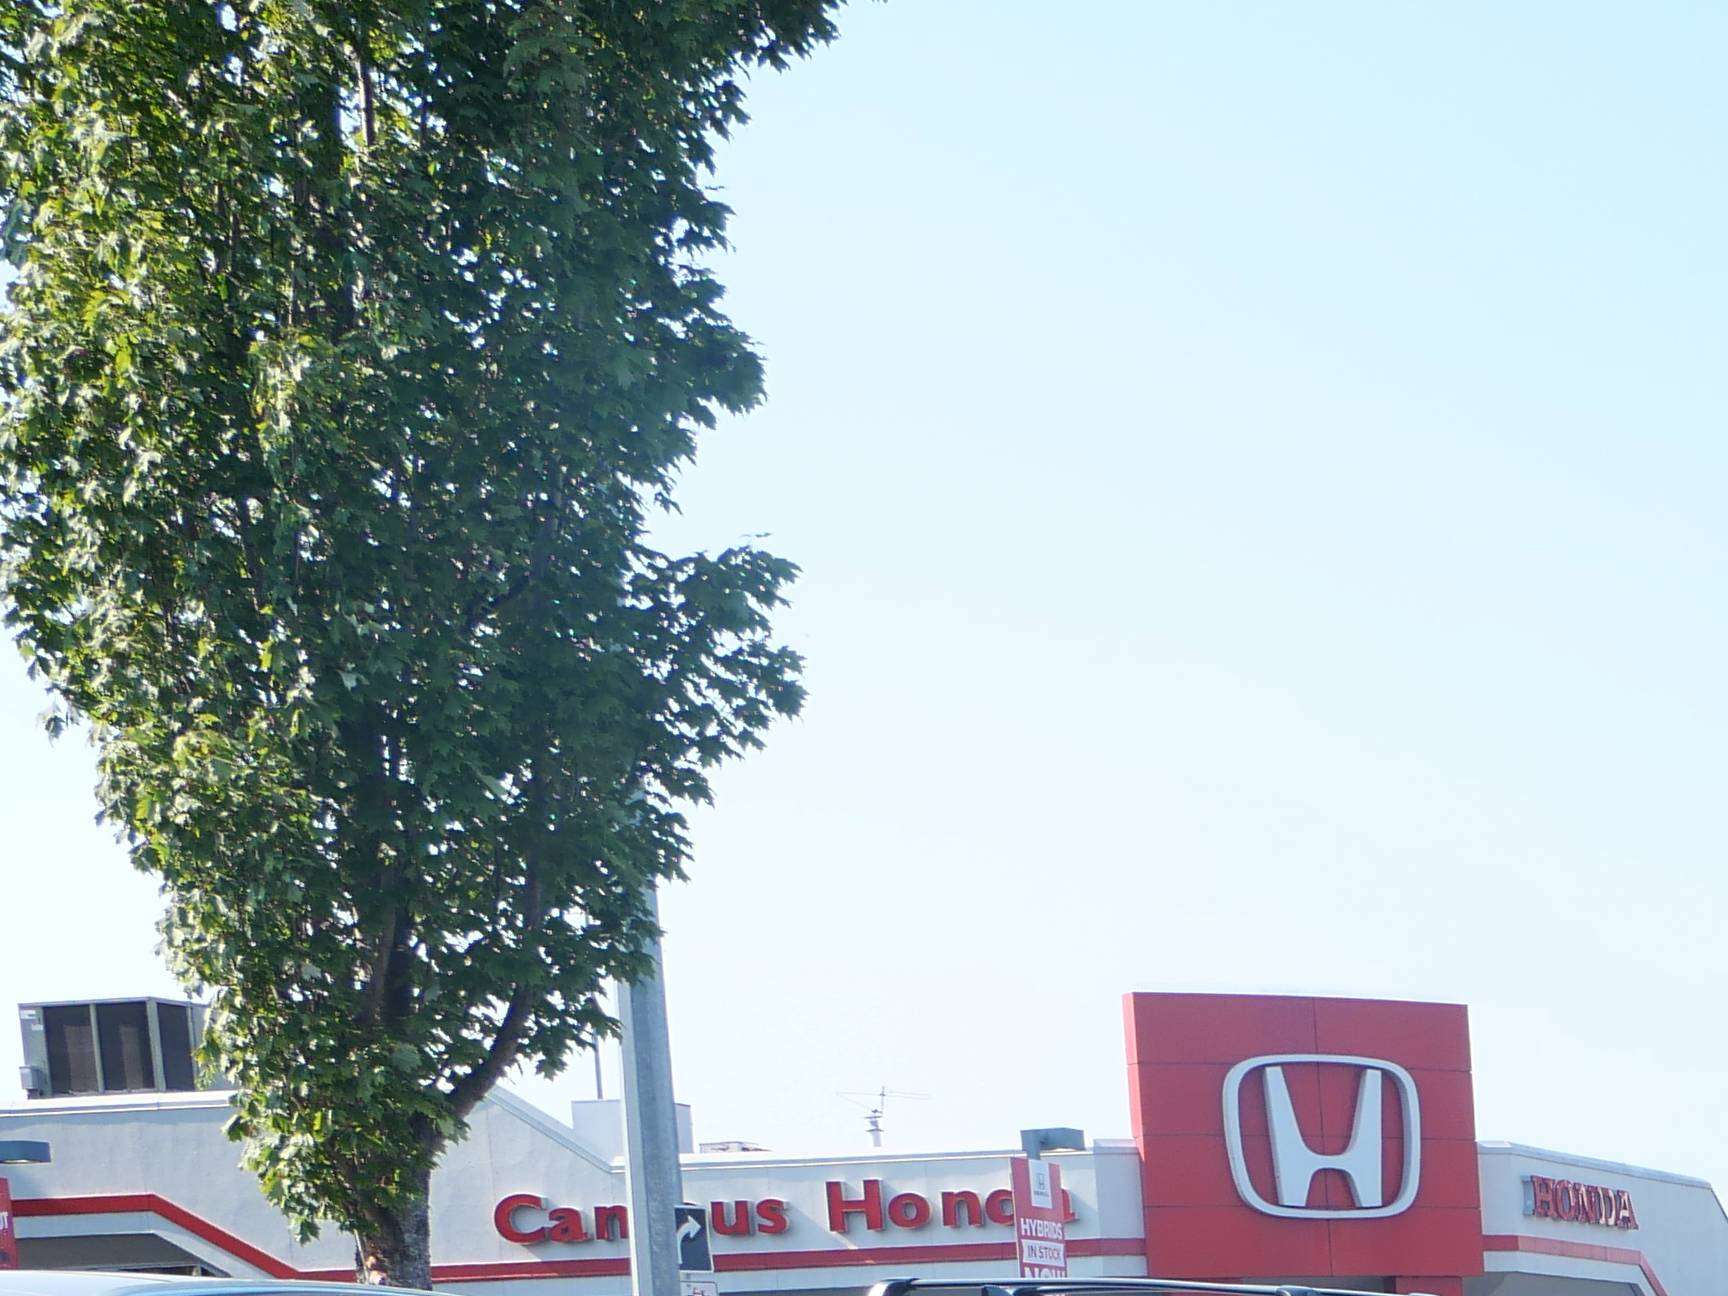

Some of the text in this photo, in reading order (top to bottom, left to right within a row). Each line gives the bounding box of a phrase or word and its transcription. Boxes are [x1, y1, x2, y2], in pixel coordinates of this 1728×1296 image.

[1522, 1174, 1639, 1231] HONDA
[1020, 1217, 1063, 1240] HYBRIDS
[1027, 1244, 1061, 1261] IN STOCK
